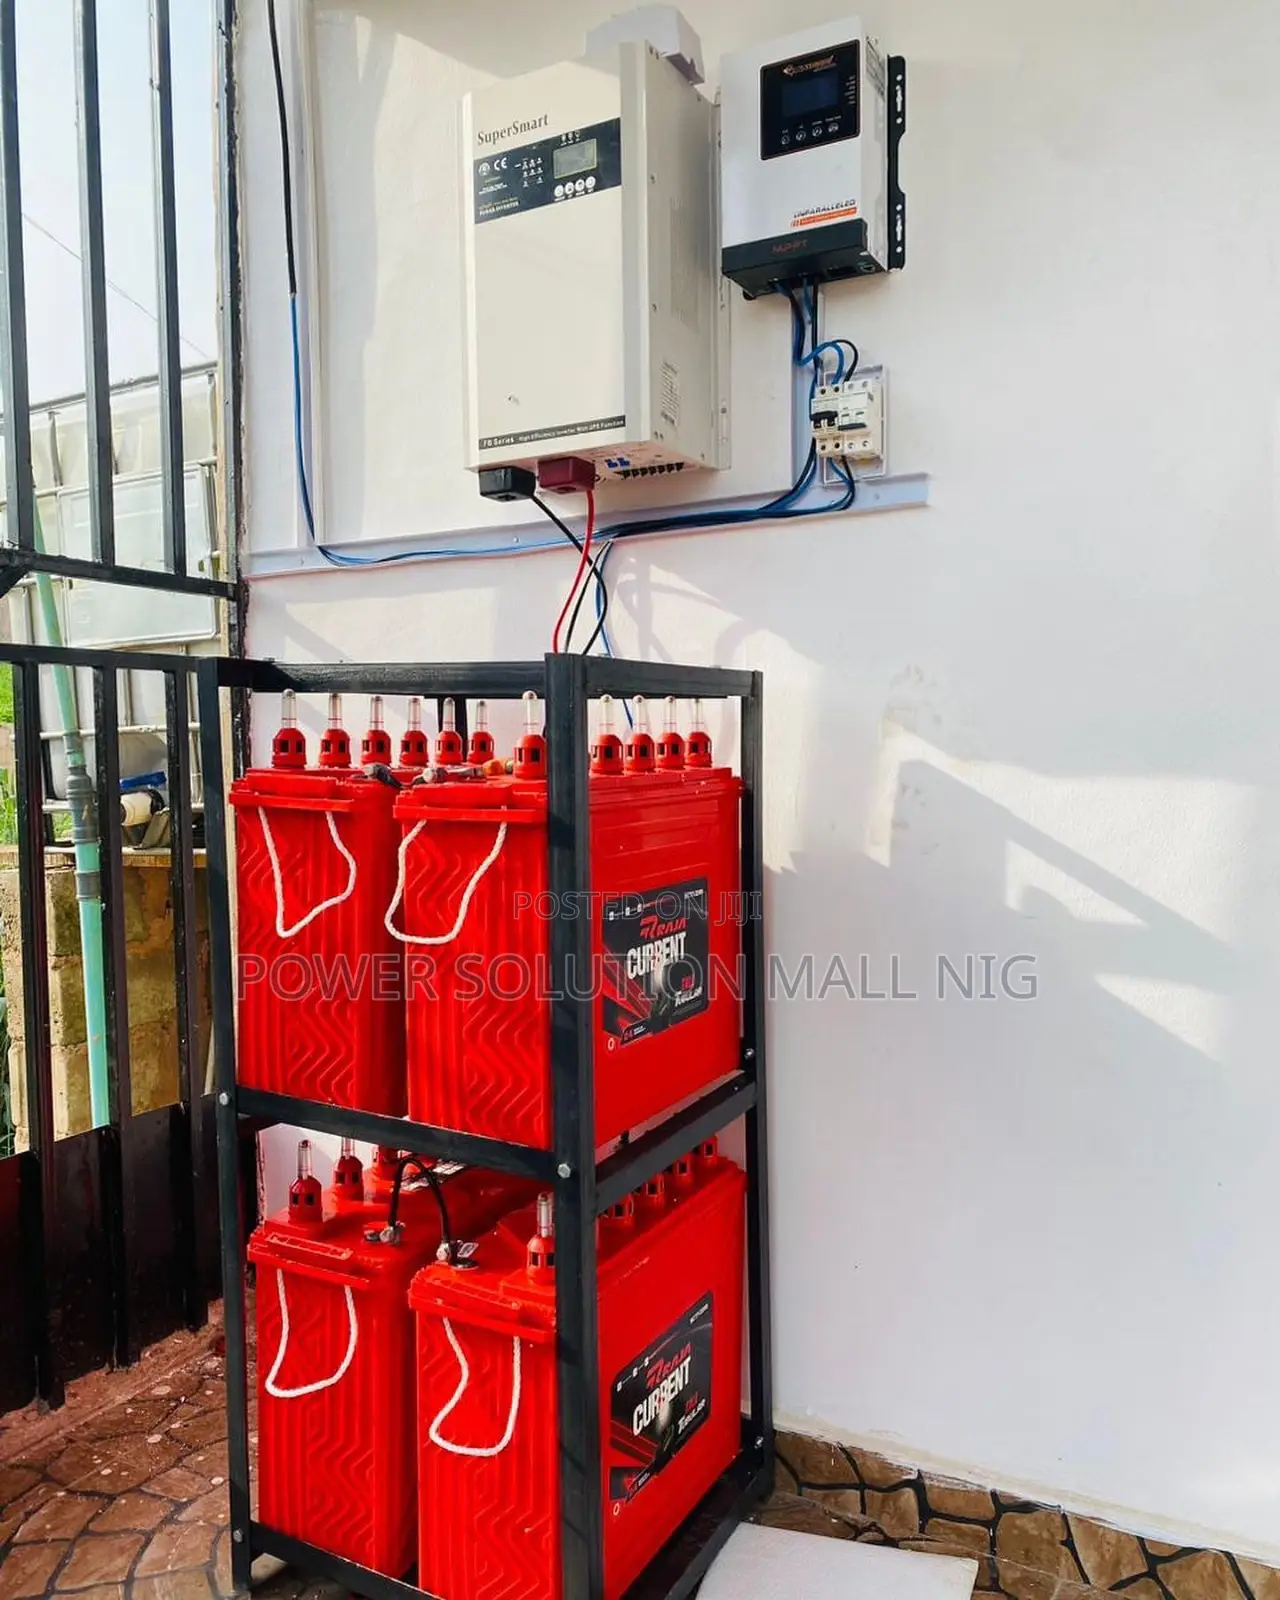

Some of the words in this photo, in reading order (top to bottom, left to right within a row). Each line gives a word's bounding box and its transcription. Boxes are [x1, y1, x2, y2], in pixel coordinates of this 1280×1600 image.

[477, 114, 549, 145] SuperSmart
[494, 157, 507, 171] CE
[627, 931, 686, 979] CURRENT
[633, 1355, 691, 1436] CURRENT
